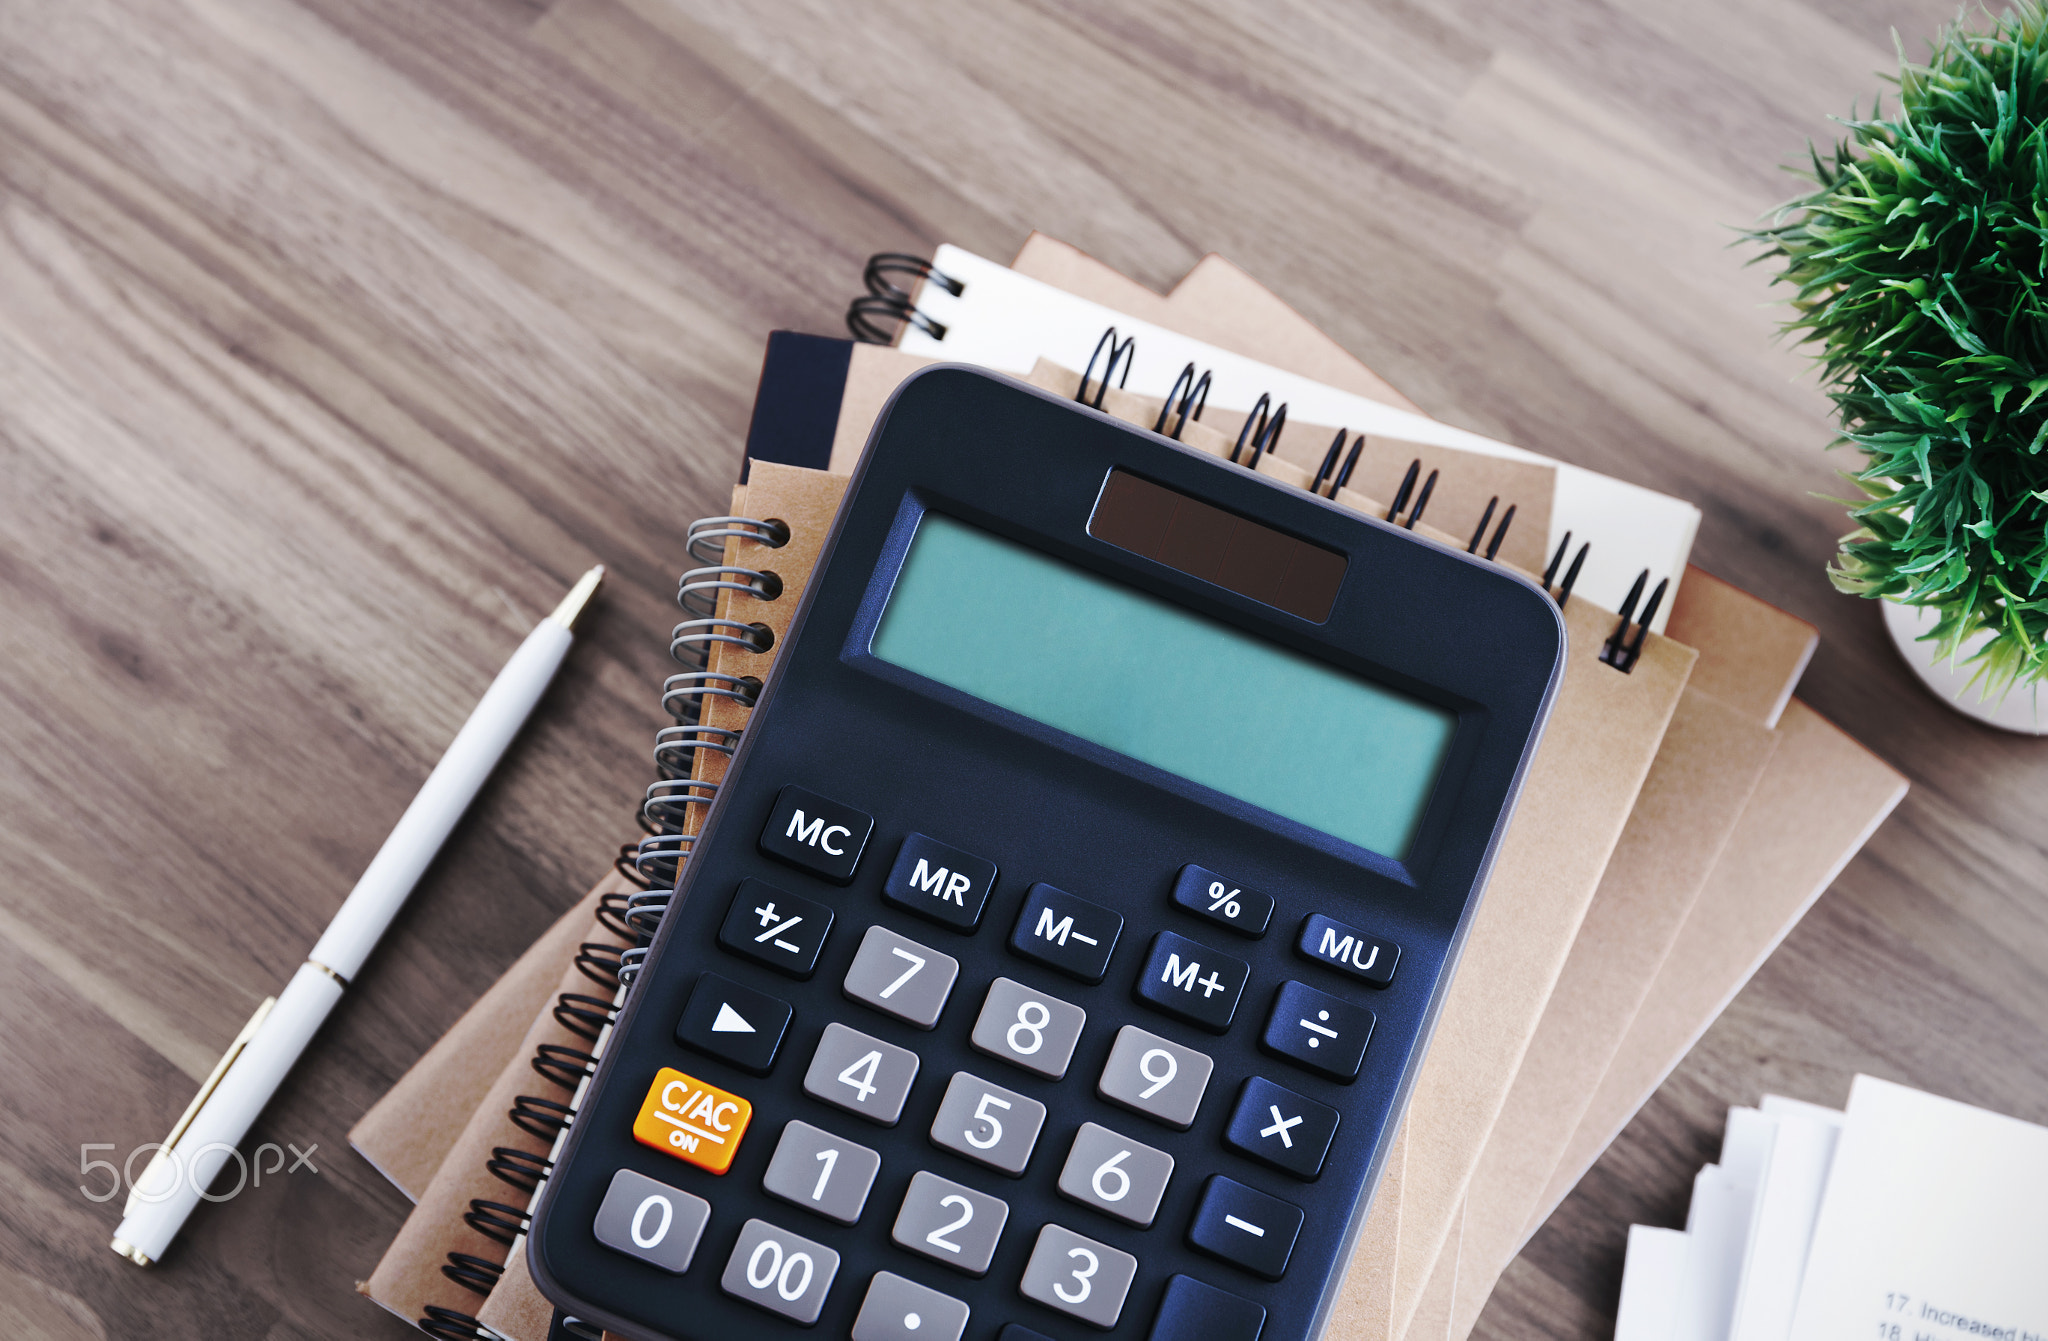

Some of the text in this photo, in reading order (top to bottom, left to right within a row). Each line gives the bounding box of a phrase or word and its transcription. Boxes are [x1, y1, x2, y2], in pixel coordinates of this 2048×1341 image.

[785, 809, 851, 856] MC
[909, 858, 971, 907] MR
[1207, 881, 1241, 918] %
[879, 946, 926, 999] 7
[1318, 927, 1379, 970] MU
[1161, 953, 1225, 998] M+
[1006, 1001, 1051, 1055] 8
[837, 1050, 883, 1102] 4
[1138, 1048, 1178, 1100] 9
[661, 1080, 739, 1132] C/AC
[964, 1092, 1012, 1149] 5
[668, 1130, 699, 1154] ON
[812, 1148, 839, 1201] 1
[1091, 1149, 1132, 1202] 6
[631, 1194, 673, 1250] 0
[925, 1194, 974, 1254] 2
[746, 1239, 814, 1301] 00
[1053, 1247, 1099, 1304] 3
[1920, 1301, 2018, 1341] Increased
